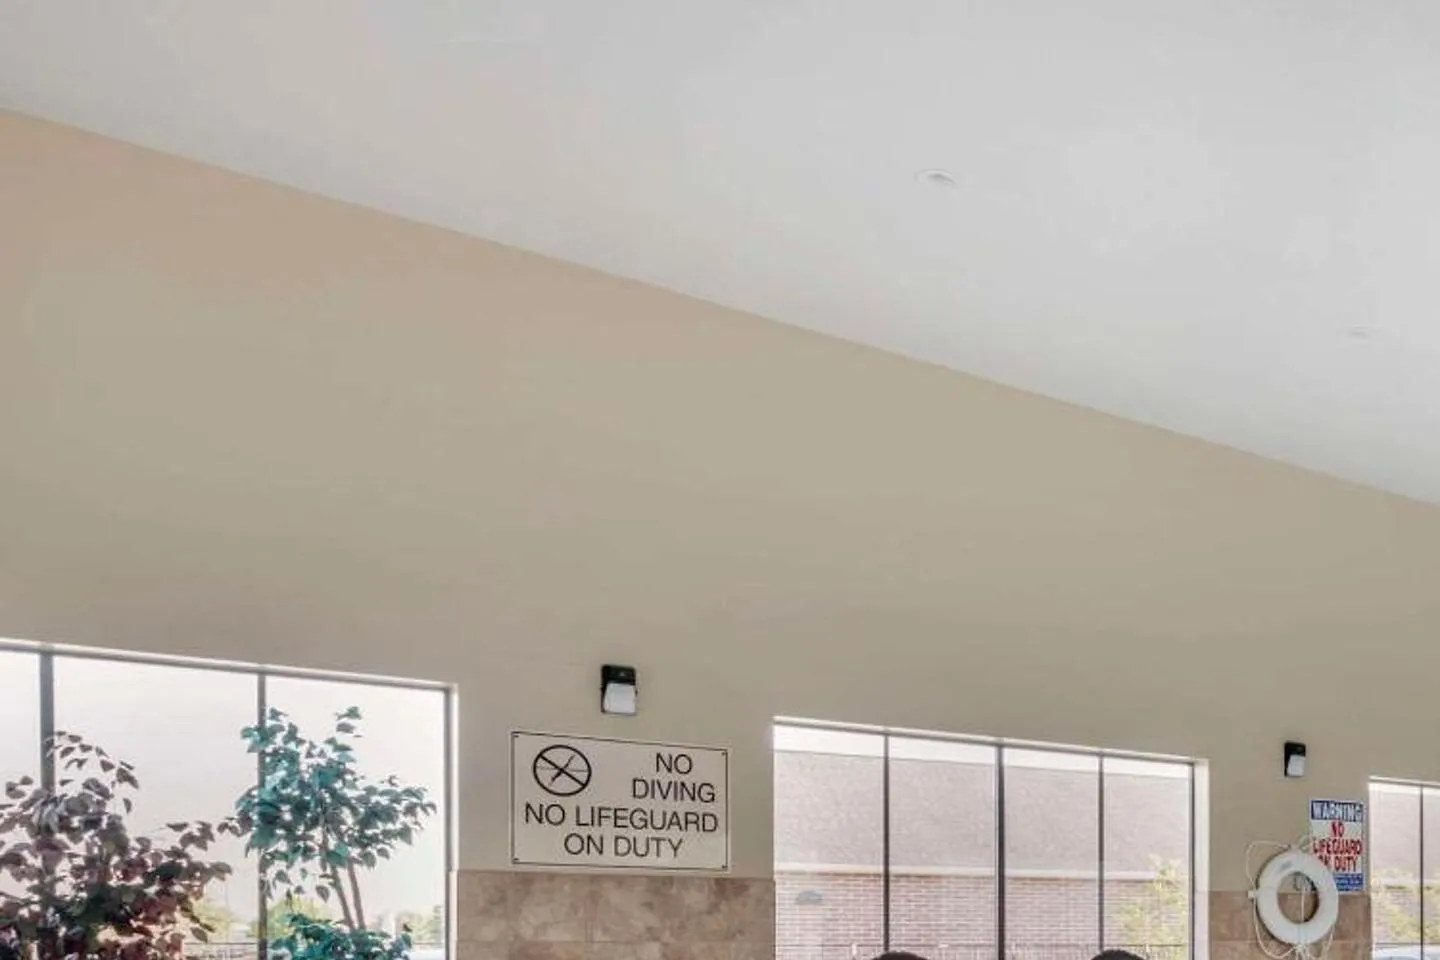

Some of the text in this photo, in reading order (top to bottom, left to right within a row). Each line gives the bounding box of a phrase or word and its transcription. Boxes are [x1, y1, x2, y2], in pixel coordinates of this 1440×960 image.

[656, 753, 693, 775] NO
[632, 778, 715, 803] DIVING
[525, 802, 718, 832] NO LIFEGUARD
[1312, 802, 1362, 821] WARNING
[1330, 822, 1344, 837] NO
[564, 833, 683, 858] ON DUTY
[1312, 838, 1363, 855] LIFEGUARD
[1335, 855, 1358, 872] DUTY
